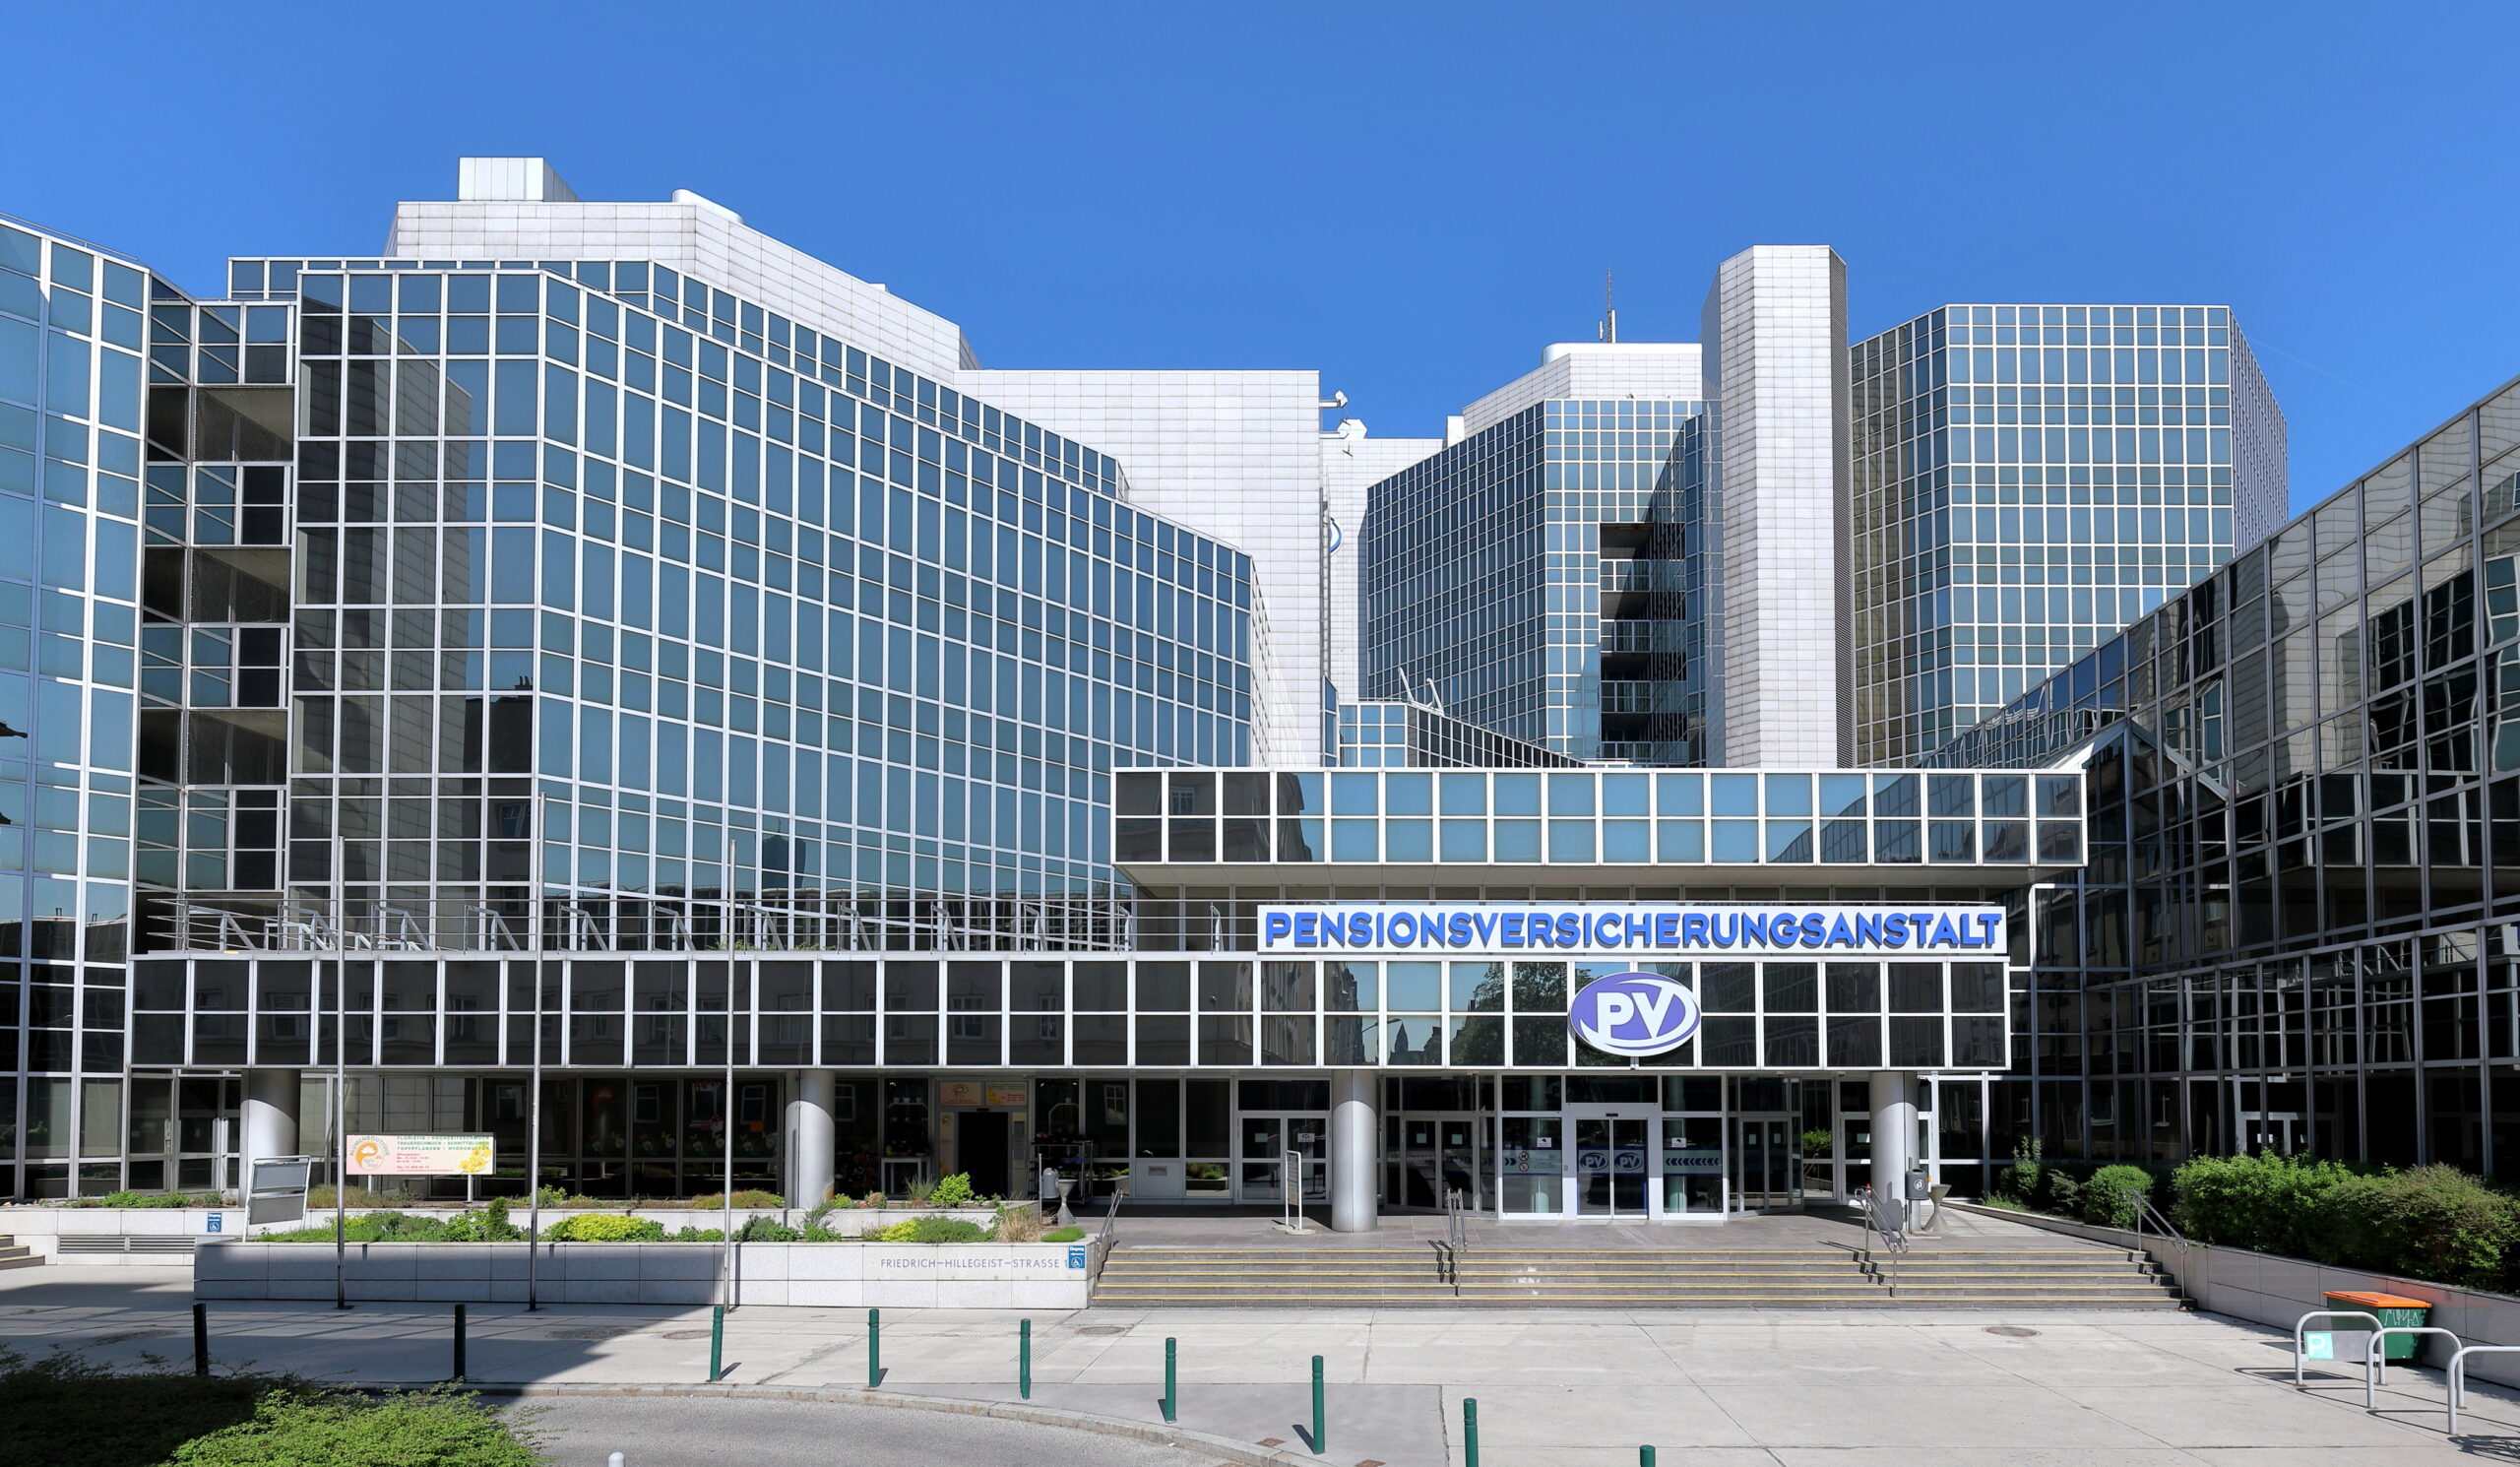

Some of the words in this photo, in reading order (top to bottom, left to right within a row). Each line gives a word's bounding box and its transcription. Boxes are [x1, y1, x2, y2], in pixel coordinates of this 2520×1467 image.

[1265, 911, 2002, 949] PENSIONSVERSICHERUNGSANSTALT
[1596, 989, 1677, 1041] PV
[349, 1136, 391, 1156] BLUMENBOUTIQUE
[1586, 1156, 1605, 1168] PV
[1620, 1156, 1638, 1168] PV
[880, 1258, 1060, 1269] FRIEDRICH-HILLEGEIST-STRASSE
[2307, 1334, 2326, 1357] P
